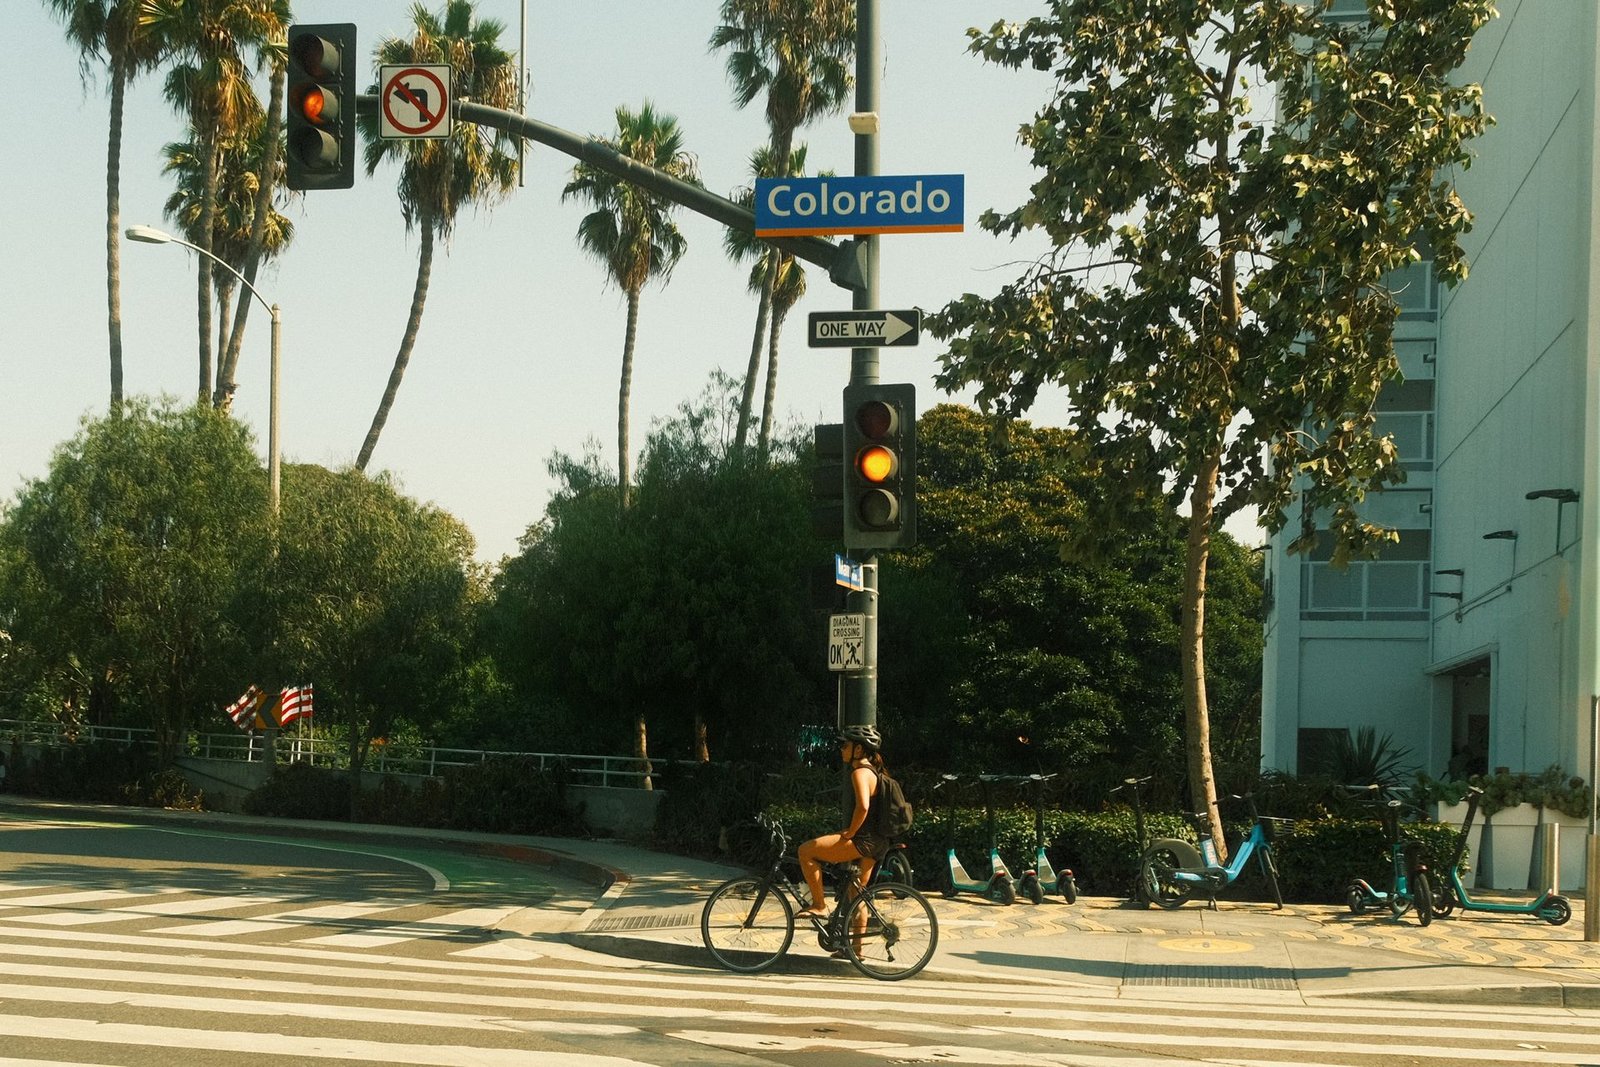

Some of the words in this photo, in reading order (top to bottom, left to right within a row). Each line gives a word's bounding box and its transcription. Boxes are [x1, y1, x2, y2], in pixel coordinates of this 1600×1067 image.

[767, 180, 950, 217] Colorado
[820, 322, 849, 337] ONE
[854, 321, 885, 336] WAY
[833, 617, 860, 627] DIAGONAL
[833, 628, 860, 637] CROSSING
[830, 644, 842, 664] OK
